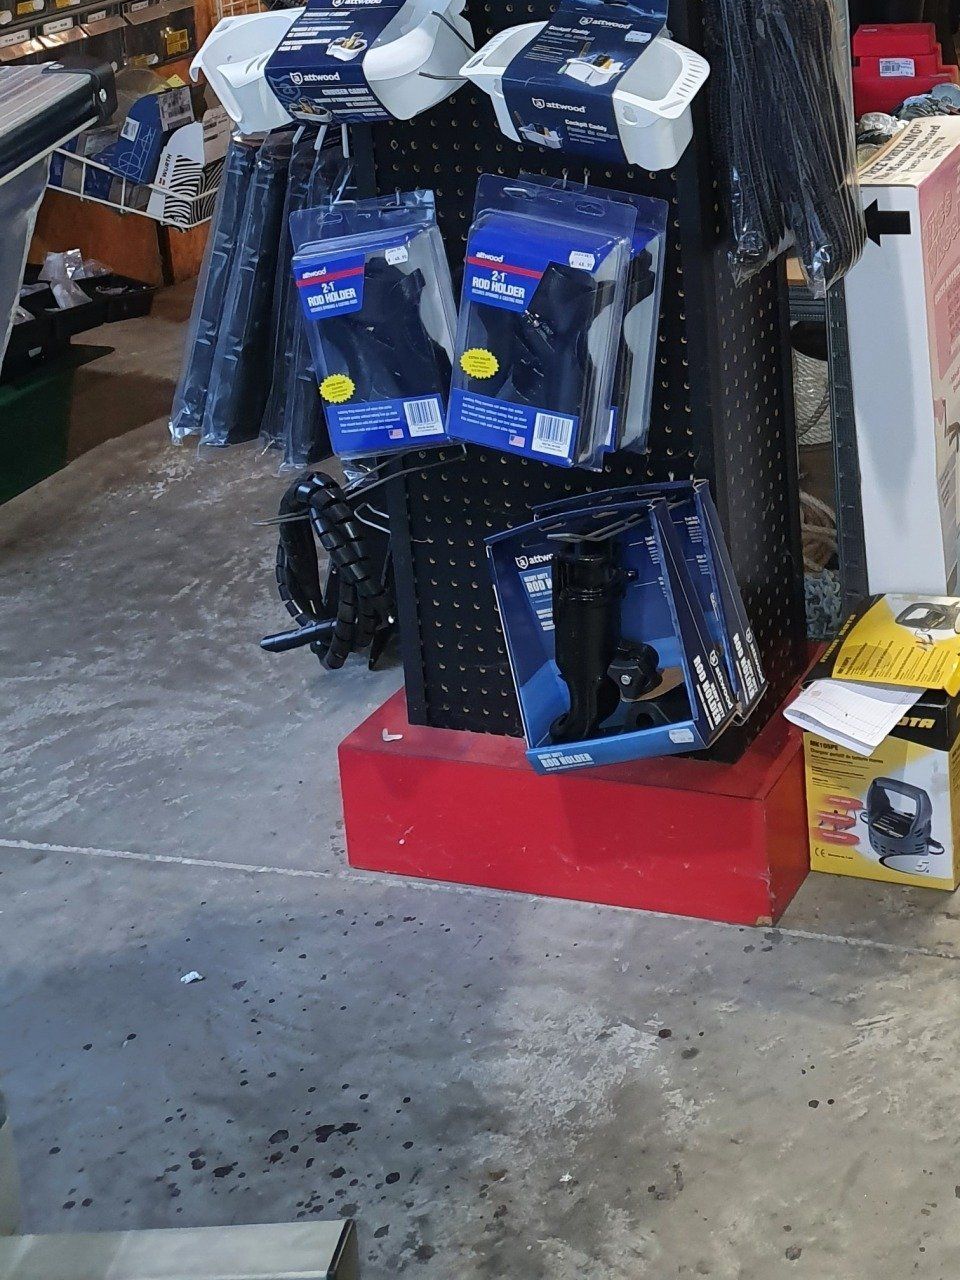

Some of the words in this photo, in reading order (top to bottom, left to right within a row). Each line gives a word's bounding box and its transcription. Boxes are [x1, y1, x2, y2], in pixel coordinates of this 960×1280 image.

[592, 19, 632, 30] attwood
[303, 72, 341, 82] attwood
[546, 102, 587, 114] attwood
[475, 251, 504, 263] attwood
[302, 266, 327, 279] attwood
[472, 276, 490, 290] ROD
[491, 281, 526, 298] HOLDER
[307, 294, 324, 307] ROD
[324, 287, 357, 304] HOLDER
[529, 553, 553, 565] attw
[526, 579, 546, 593] ROD
[733, 633, 743, 658] ROD
[740, 656, 755, 699] HOLDER
[749, 643, 765, 684] attwood
[692, 655, 707, 682] ROD
[702, 680, 722, 725] HOLDER
[714, 666, 734, 710] attwood
[896, 716, 937, 729] OTA
[541, 757, 561, 768] ROD
[558, 753, 594, 766] HOLDER
